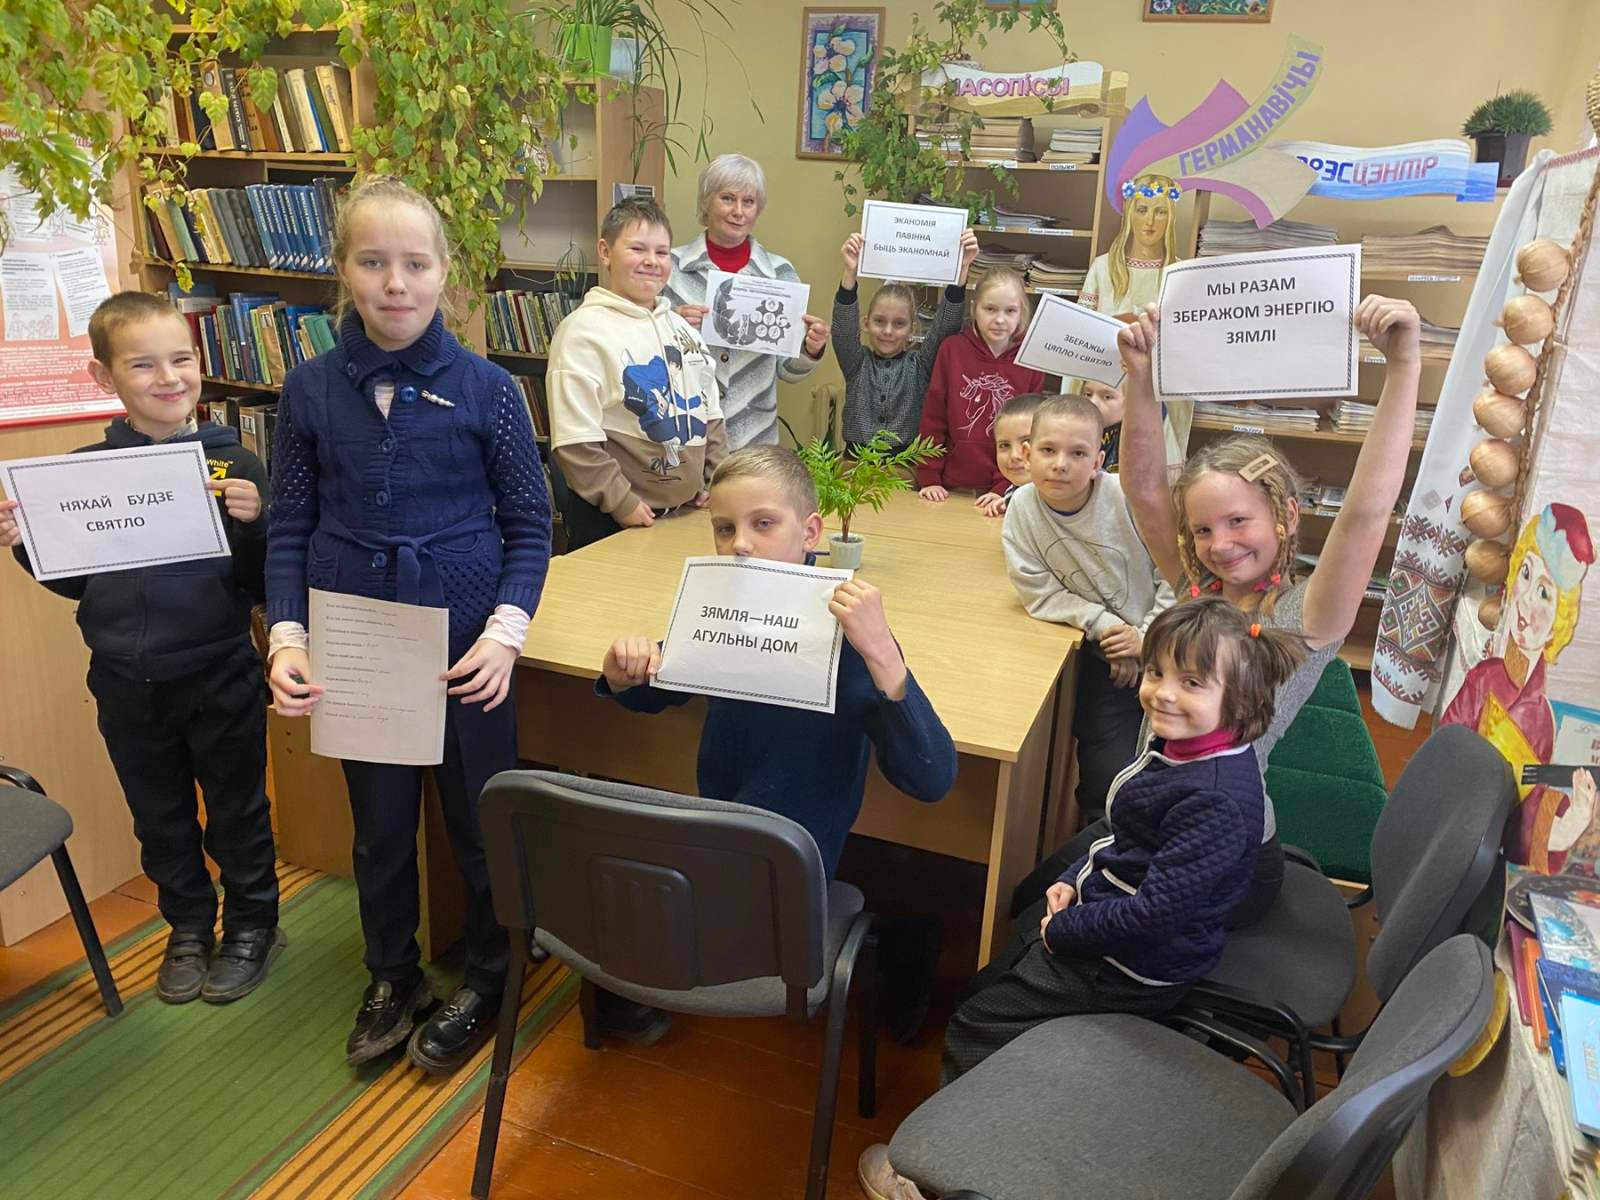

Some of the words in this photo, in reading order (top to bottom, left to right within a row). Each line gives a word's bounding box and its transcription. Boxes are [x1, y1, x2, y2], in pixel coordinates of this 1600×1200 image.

[894, 216, 936, 229] ЭКАНОМІЯ
[895, 231, 931, 242] ПАВІННА
[873, 243, 897, 254] БЫЦЬ
[898, 246, 950, 258] ЭКАНОМНАЙ
[1206, 282, 1236, 297] МЫ
[1240, 277, 1296, 294] РАЗАМ
[1172, 305, 1260, 324] ЗБЕРАЖОМ
[1264, 299, 1335, 317] ЭНЕРГІЮ
[1063, 334, 1106, 355] ЗБЕРАЖЫ
[1226, 329, 1276, 344] ЗЯМЛІ
[1044, 342, 1074, 358] ЦЯПЛО
[1079, 354, 1113, 367] СВЯТЛО
[59, 495, 113, 512] НЯХАЙ
[126, 490, 175, 506] БУДЗЕ
[86, 516, 145, 532] СВЯТЛО
[692, 629, 758, 649] АГУЛЬНЫ
[760, 638, 798, 654] ДОМ
